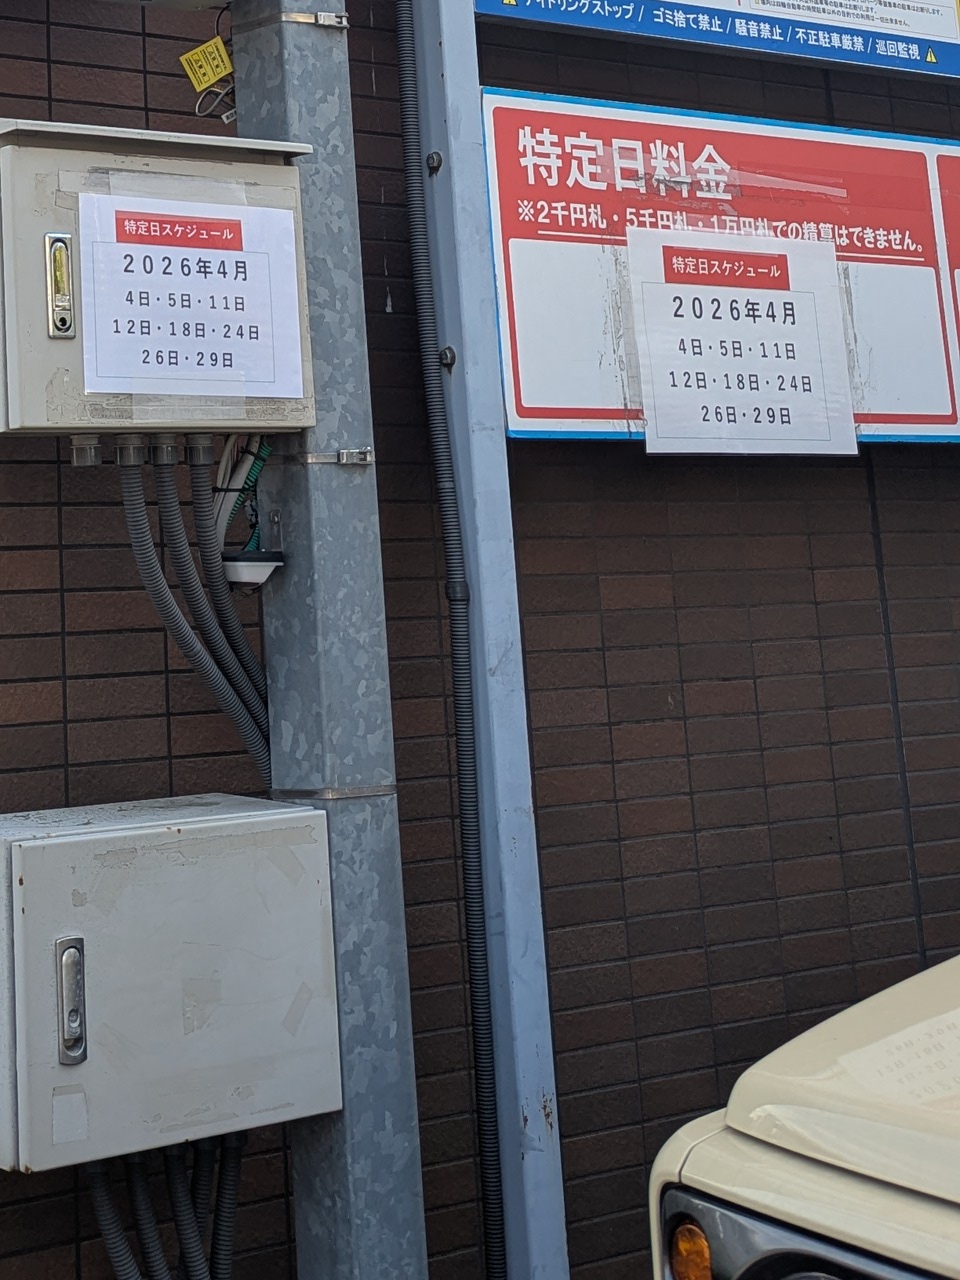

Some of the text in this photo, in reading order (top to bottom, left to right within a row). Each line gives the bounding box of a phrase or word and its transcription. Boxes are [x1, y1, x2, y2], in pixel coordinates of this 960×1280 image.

[653, 8, 723, 32] ゴミ捨て禁止
[735, 18, 784, 41] 騒音禁止
[875, 39, 921, 61] 巡回監視
[517, 125, 733, 202] 特定日料金
[124, 219, 235, 241] 特定日スケジュール
[671, 256, 781, 280] 特定日スケジュール
